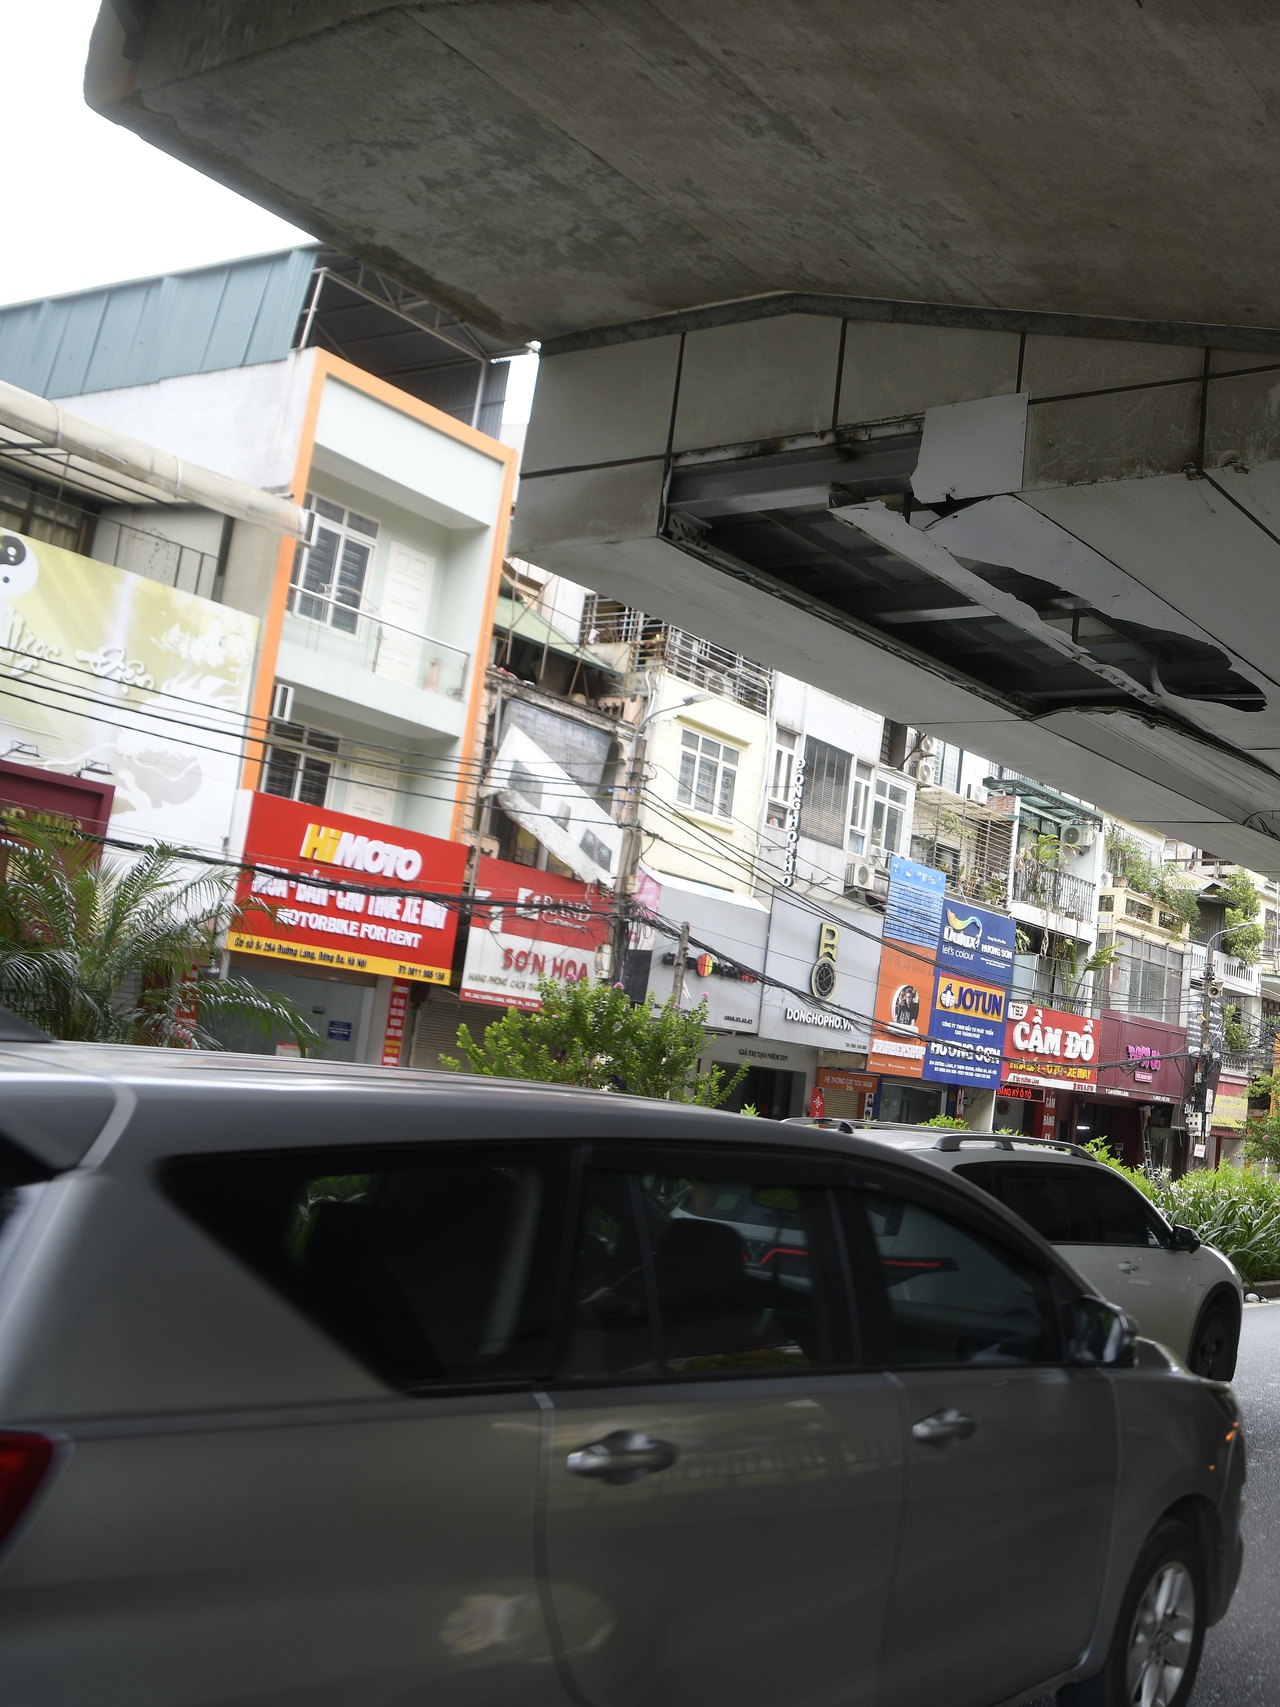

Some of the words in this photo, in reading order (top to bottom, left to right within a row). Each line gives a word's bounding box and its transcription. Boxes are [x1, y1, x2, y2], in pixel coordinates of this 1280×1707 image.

[276, 908, 360, 938] MOTORBIKE
[360, 922, 387, 942] FOR
[387, 927, 423, 949] RENT
[955, 949, 974, 961] colour
[955, 986, 1003, 1017] JOTUN
[1012, 1009, 1063, 1057] CẦM
[1063, 1020, 1095, 1062] ĐỒ
